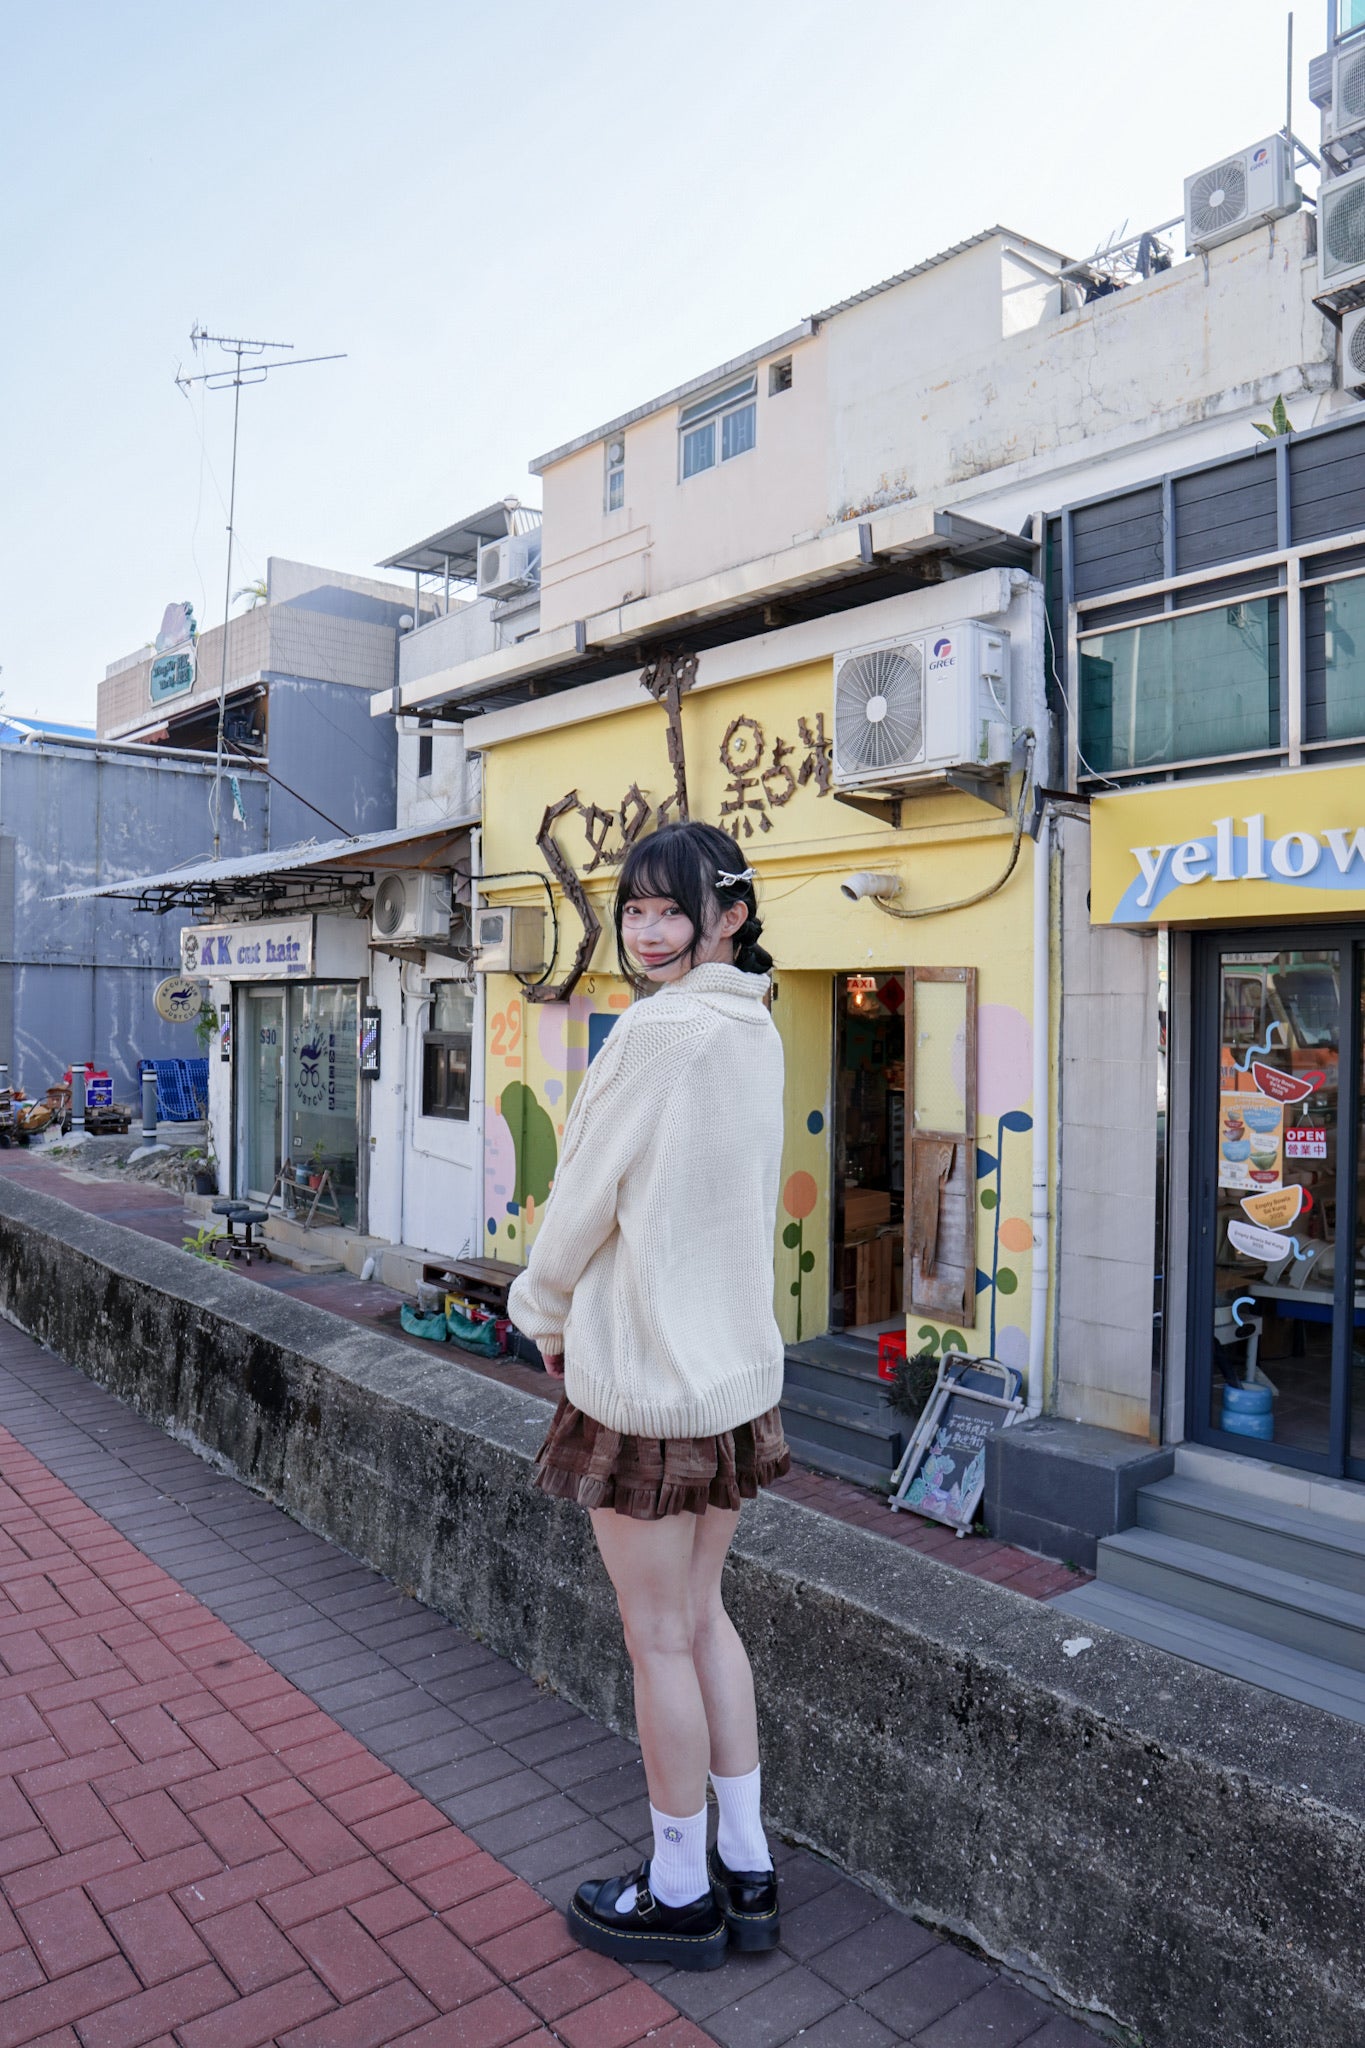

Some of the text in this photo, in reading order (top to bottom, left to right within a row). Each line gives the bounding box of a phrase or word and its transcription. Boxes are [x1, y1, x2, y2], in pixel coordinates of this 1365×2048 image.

[929, 657, 956, 670] GREE
[236, 943, 261, 965] cut
[266, 936, 300, 963] hair
[847, 979, 873, 989] TAXI
[489, 1000, 522, 1056] 29
[1286, 1130, 1325, 1142] OPEN
[1287, 1144, 1325, 1157] 營業中
[1255, 1200, 1273, 1210] Empty
[1272, 1204, 1287, 1212] Kung
